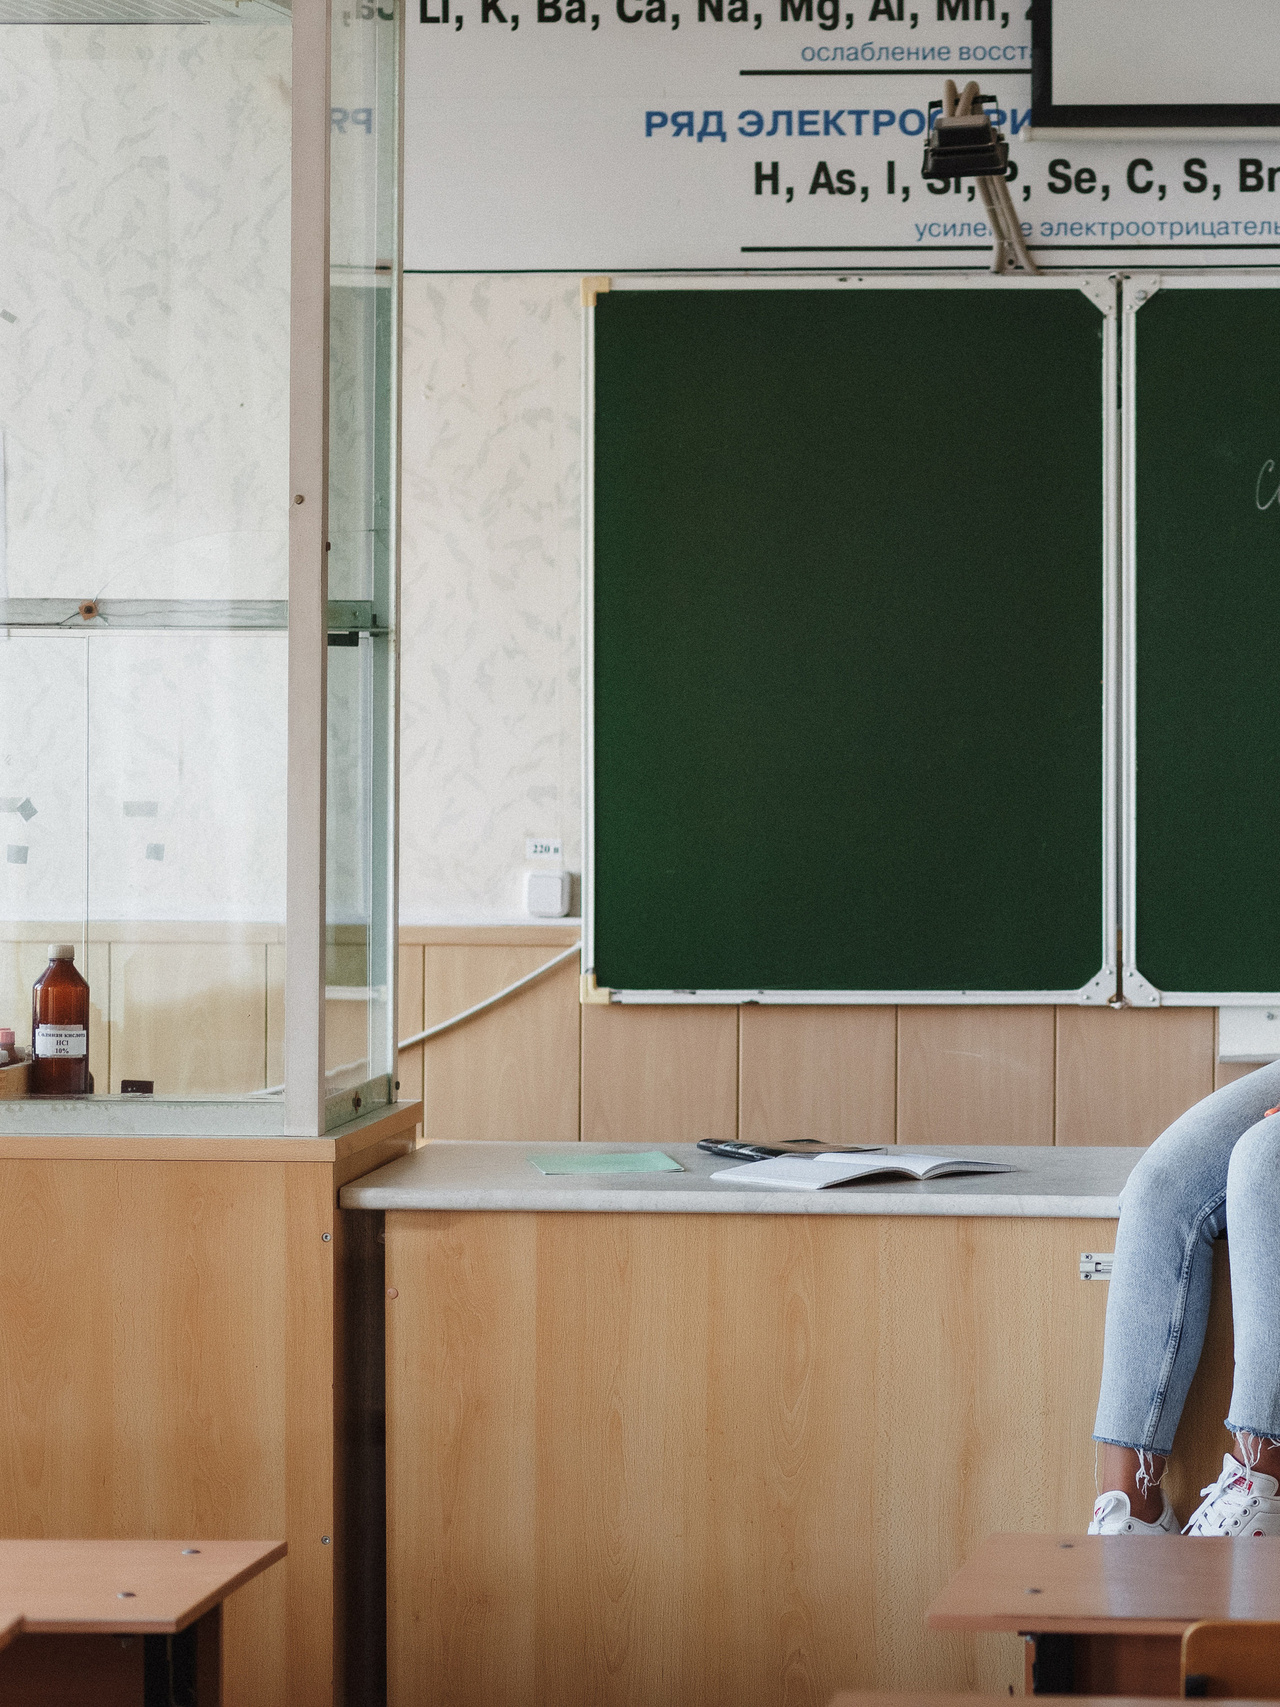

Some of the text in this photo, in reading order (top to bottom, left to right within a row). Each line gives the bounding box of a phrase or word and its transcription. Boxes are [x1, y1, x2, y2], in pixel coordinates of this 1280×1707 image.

[801, 42, 1032, 62] ослабление восст
[645, 110, 727, 142] РЯД
[754, 161, 795, 203] H,
[809, 161, 870, 203] As,
[1047, 158, 1111, 202] Se,
[1126, 158, 1168, 201] C,
[1182, 157, 1222, 201] S,
[533, 844, 551, 854] 220
